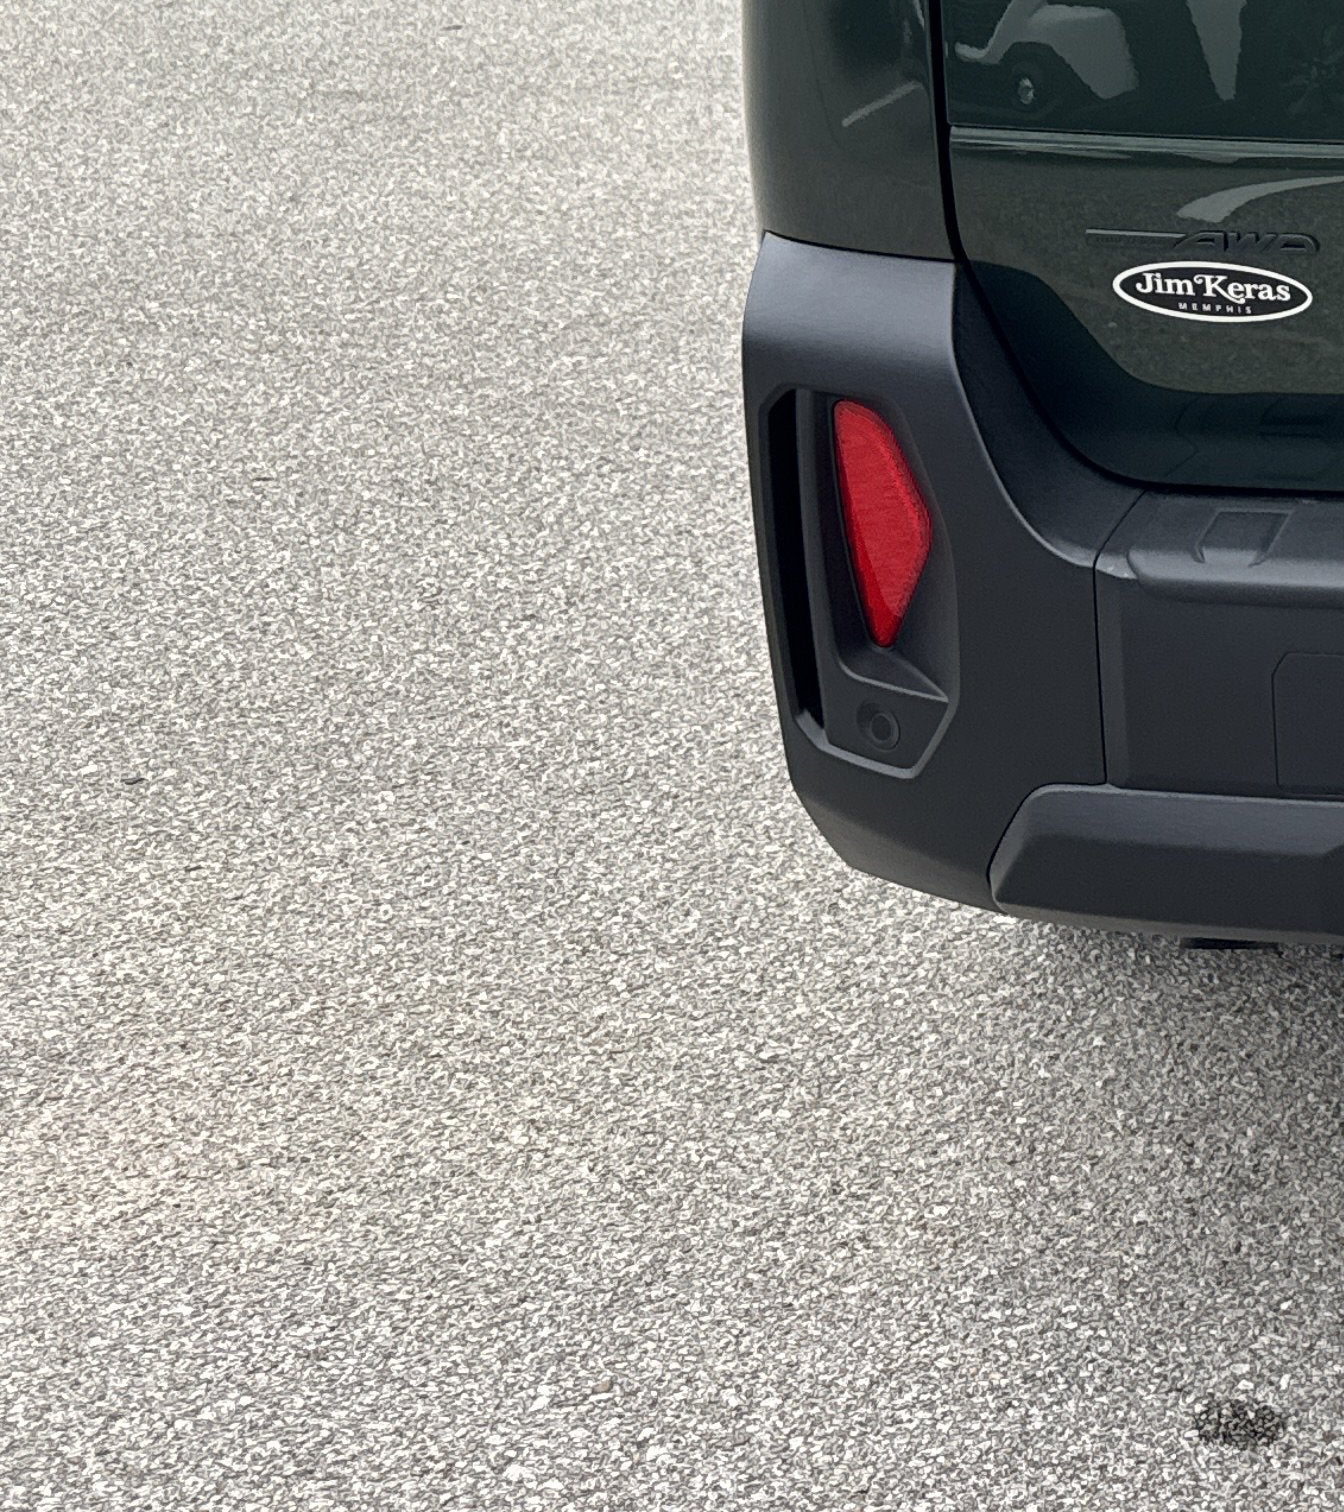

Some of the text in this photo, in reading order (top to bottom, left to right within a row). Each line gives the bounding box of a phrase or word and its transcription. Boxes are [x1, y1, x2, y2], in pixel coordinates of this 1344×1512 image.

[1173, 229, 1321, 253] AWD
[1135, 271, 1291, 304] Jim Keras
[1178, 302, 1252, 314] MEMPHIS
